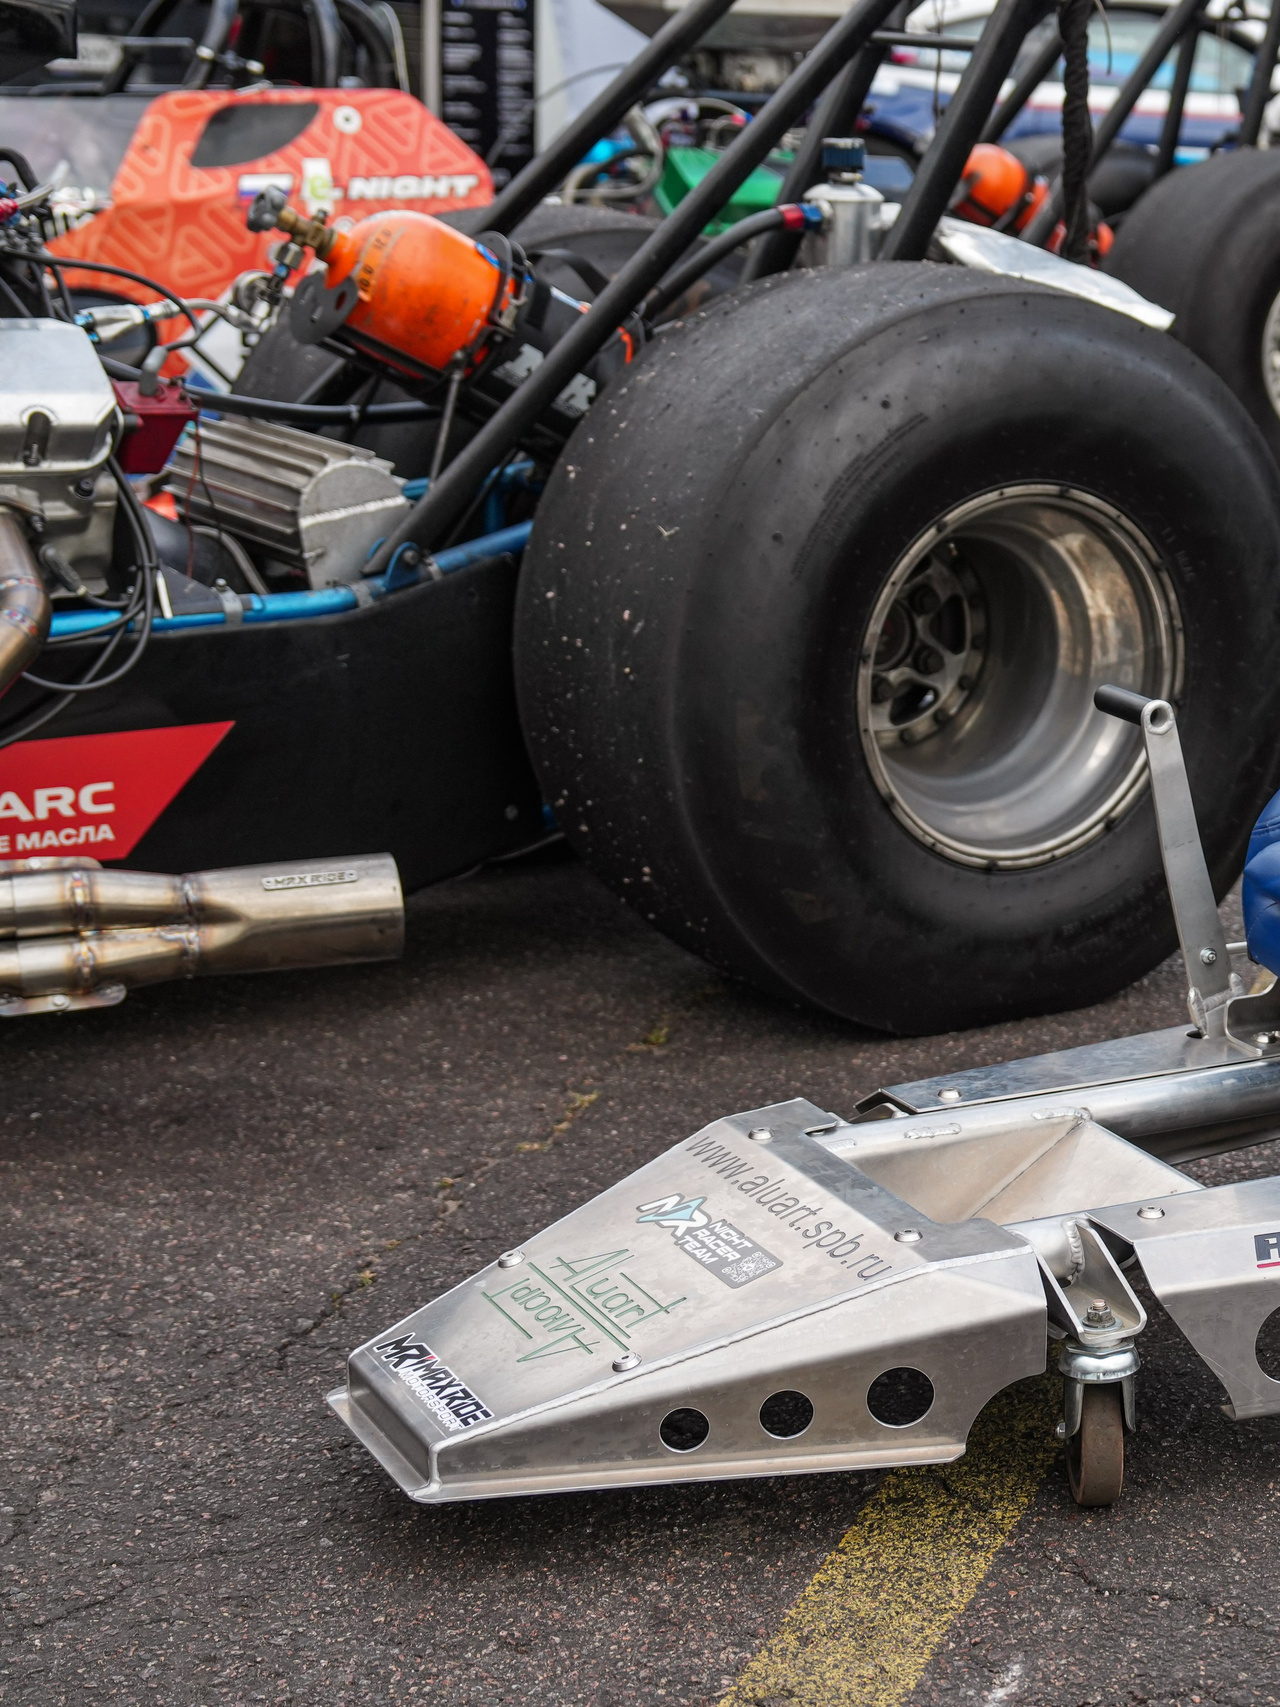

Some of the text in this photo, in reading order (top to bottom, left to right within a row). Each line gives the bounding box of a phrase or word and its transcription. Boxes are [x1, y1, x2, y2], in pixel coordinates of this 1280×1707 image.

[349, 174, 479, 200] NIGHT
[16, 823, 116, 852] МАСЛА
[685, 1136, 893, 1281] www.aluart.spb.ru
[691, 1228, 742, 1262] RACER
[708, 1221, 754, 1249] NIGHT
[676, 1236, 719, 1265] TEAM
[398, 1370, 464, 1431] MOTORSPORT
